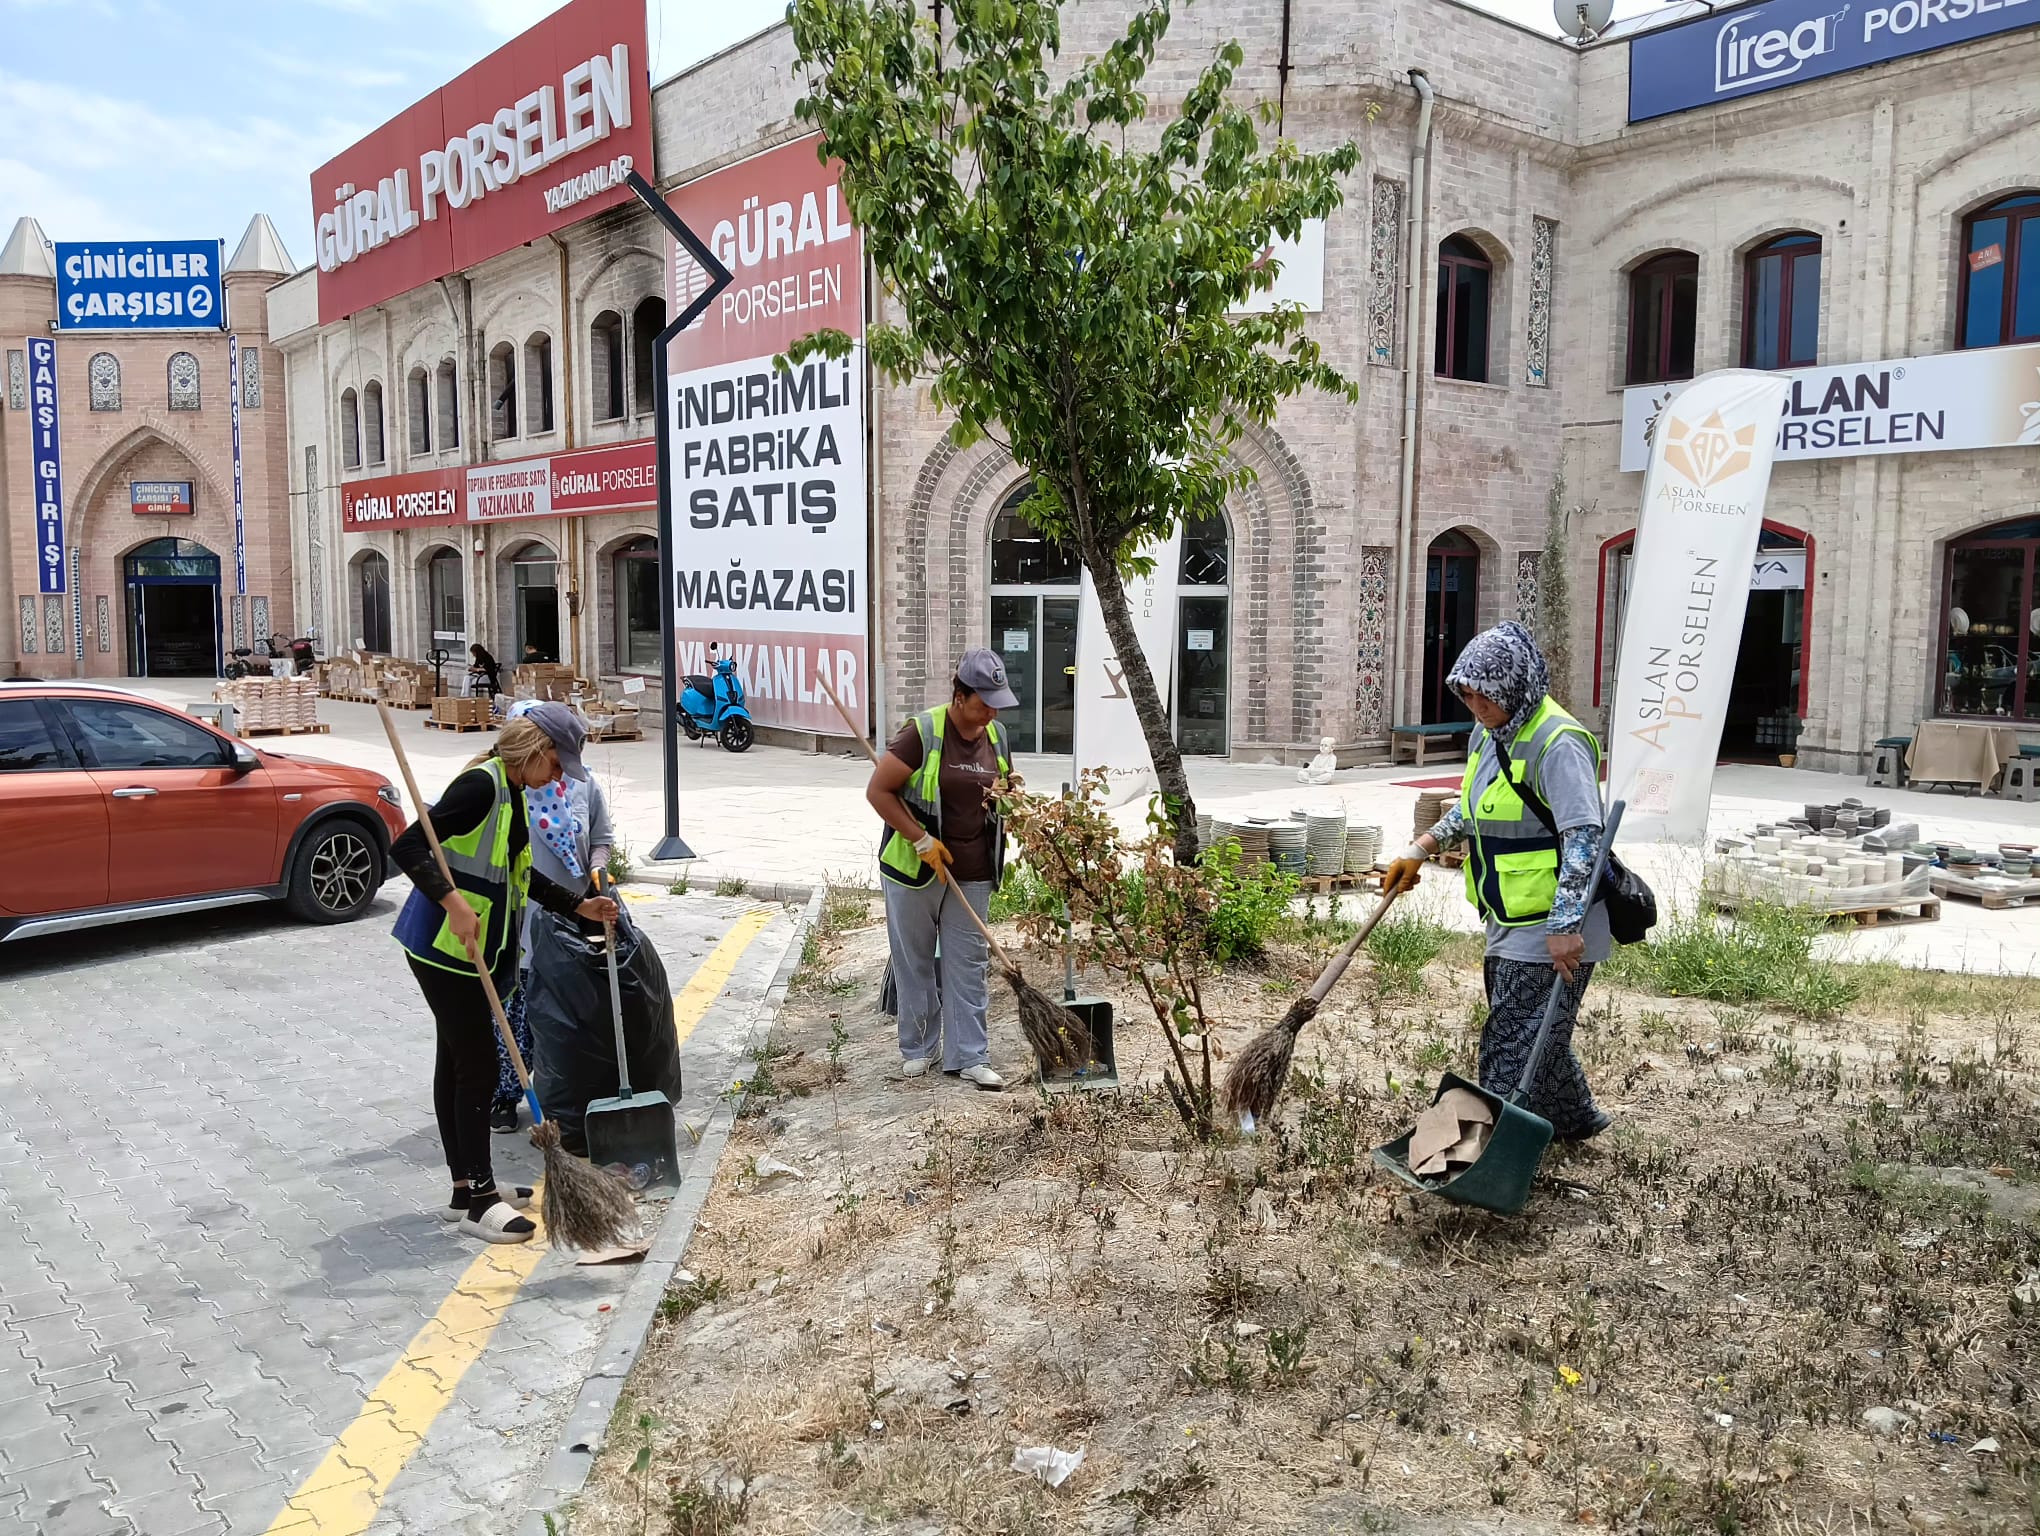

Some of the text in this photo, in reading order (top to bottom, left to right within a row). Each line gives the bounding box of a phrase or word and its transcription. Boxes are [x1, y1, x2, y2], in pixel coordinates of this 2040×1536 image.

[316, 43, 632, 273] GÜRAL PORSELEN
[543, 154, 634, 214] YAZIKANLAR
[710, 183, 851, 272] GÜRAL
[67, 291, 183, 324] ÇARŞISI
[721, 263, 842, 329] PORSELEN
[34, 342, 54, 449] ÇARŞI
[230, 338, 239, 448] ÇARŞI
[172, 494, 180, 503] 2
[355, 488, 456, 522] GÜRAL PORSELEN
[477, 491, 535, 517] YAZIKANLAR
[488, 475, 495, 491] VE
[496, 471, 529, 490] PERAKENDE
[560, 470, 601, 497] GÜRAL
[689, 479, 837, 534] SATIŞ
[1656, 483, 1707, 501] ASLAN
[1671, 497, 1748, 515] PORSELEN
[676, 557, 856, 614] MAĞAZASI
[1663, 556, 1719, 721] PORSELEN
[1628, 646, 1672, 753] ASLAN
